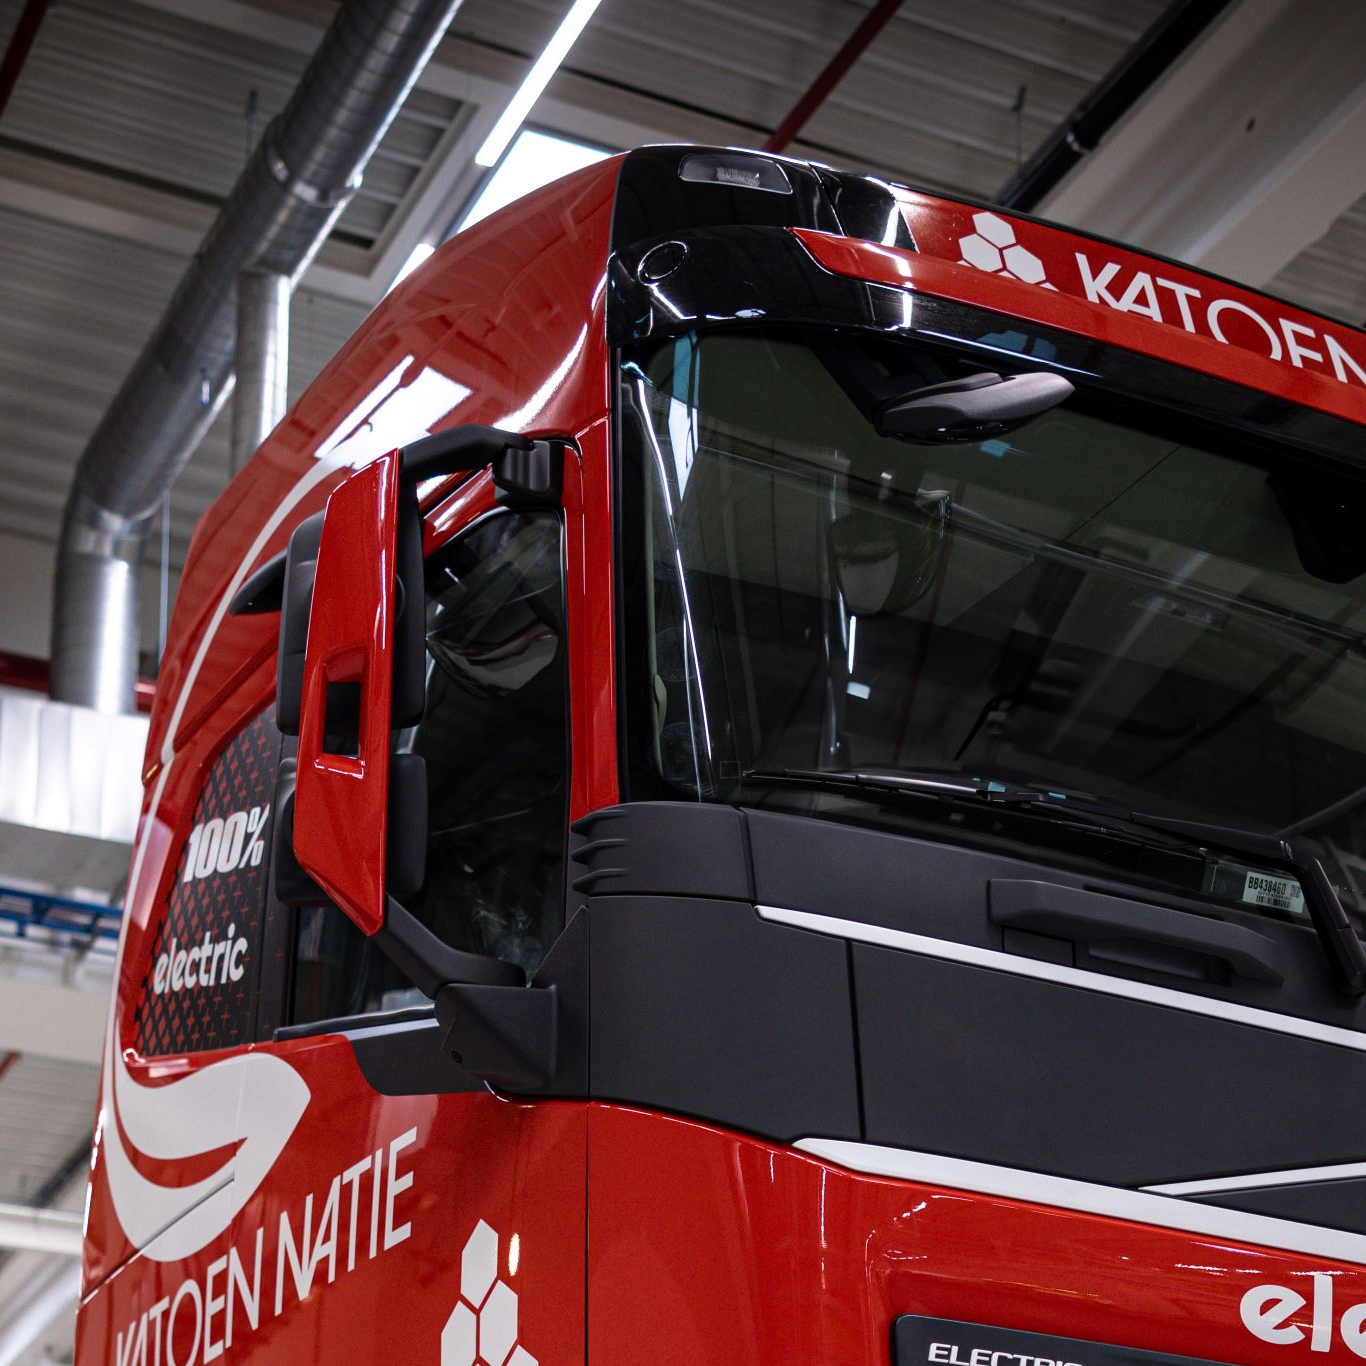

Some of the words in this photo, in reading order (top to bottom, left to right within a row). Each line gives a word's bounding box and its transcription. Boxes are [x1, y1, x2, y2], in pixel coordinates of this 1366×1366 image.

[183, 803, 271, 883] 100%
[153, 922, 249, 995] electric
[274, 1126, 418, 1317] NATIE
